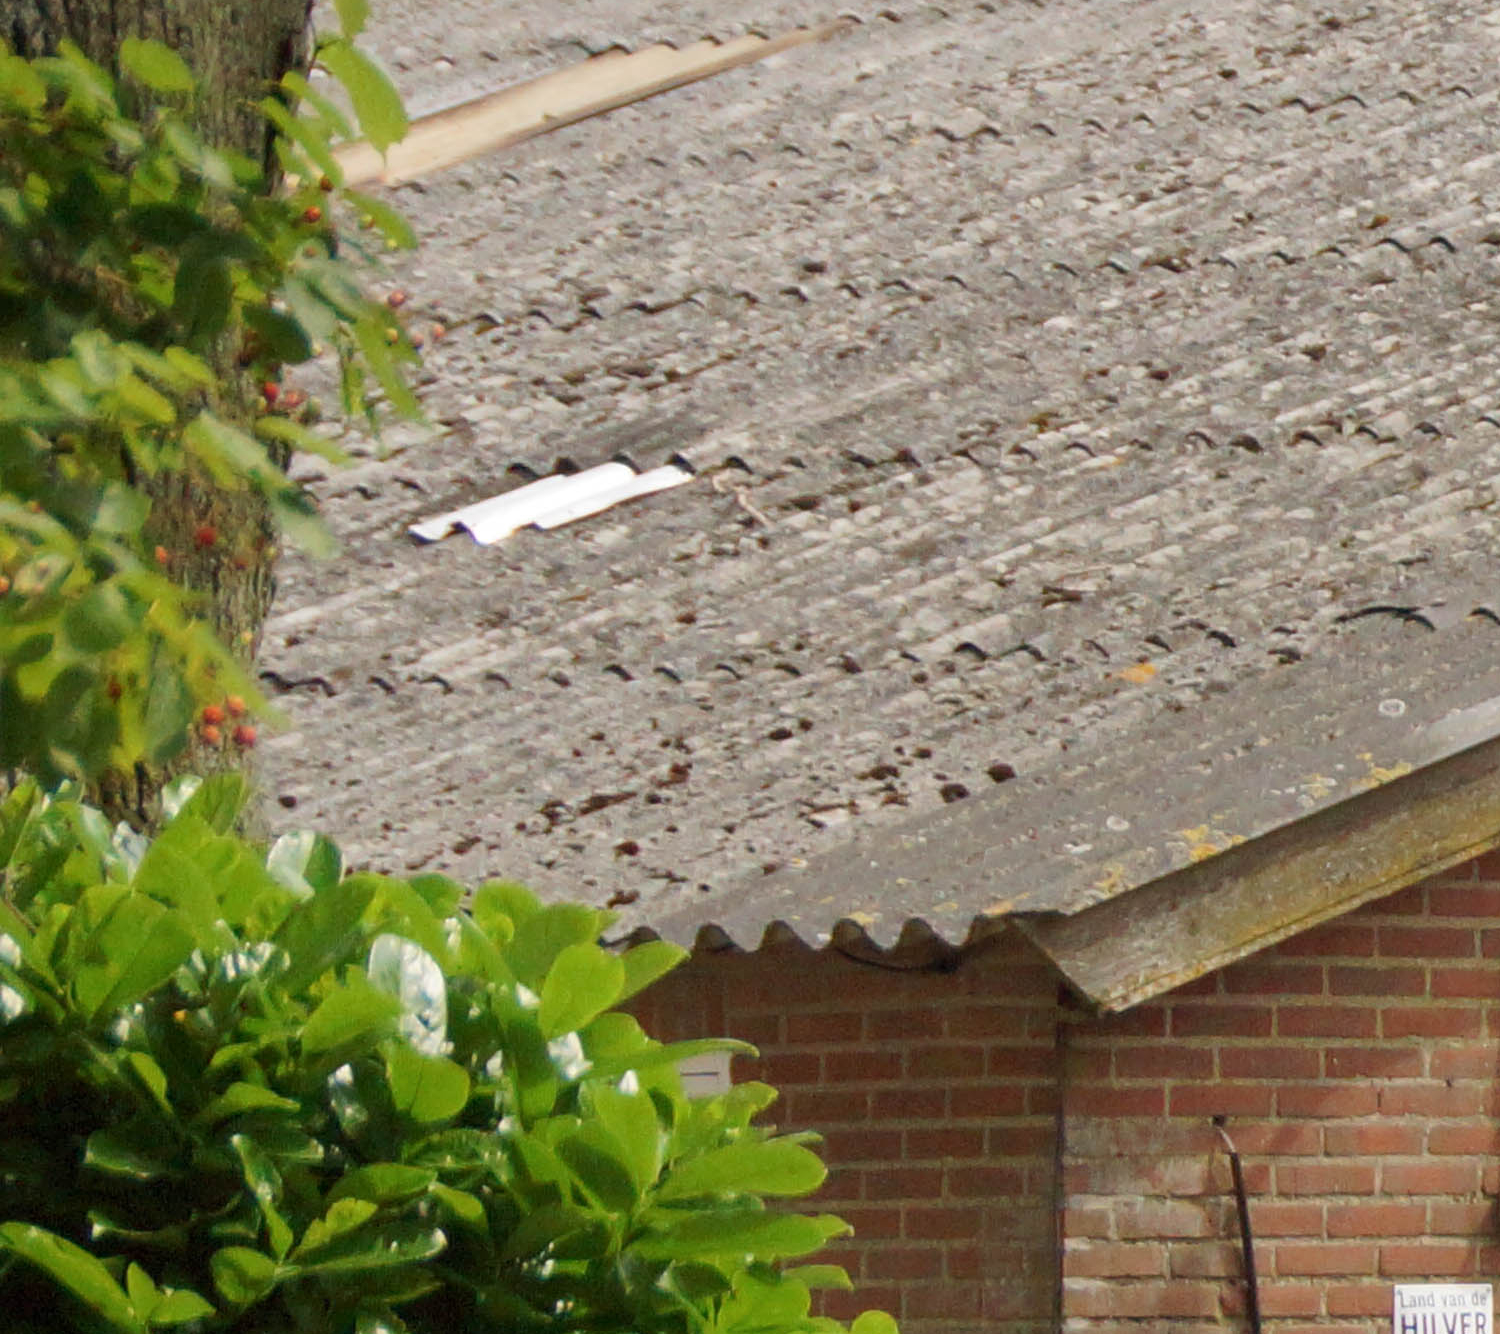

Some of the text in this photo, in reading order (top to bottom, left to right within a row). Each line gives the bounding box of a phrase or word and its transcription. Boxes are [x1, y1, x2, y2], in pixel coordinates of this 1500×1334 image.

[1400, 1291, 1487, 1308] Land van de
